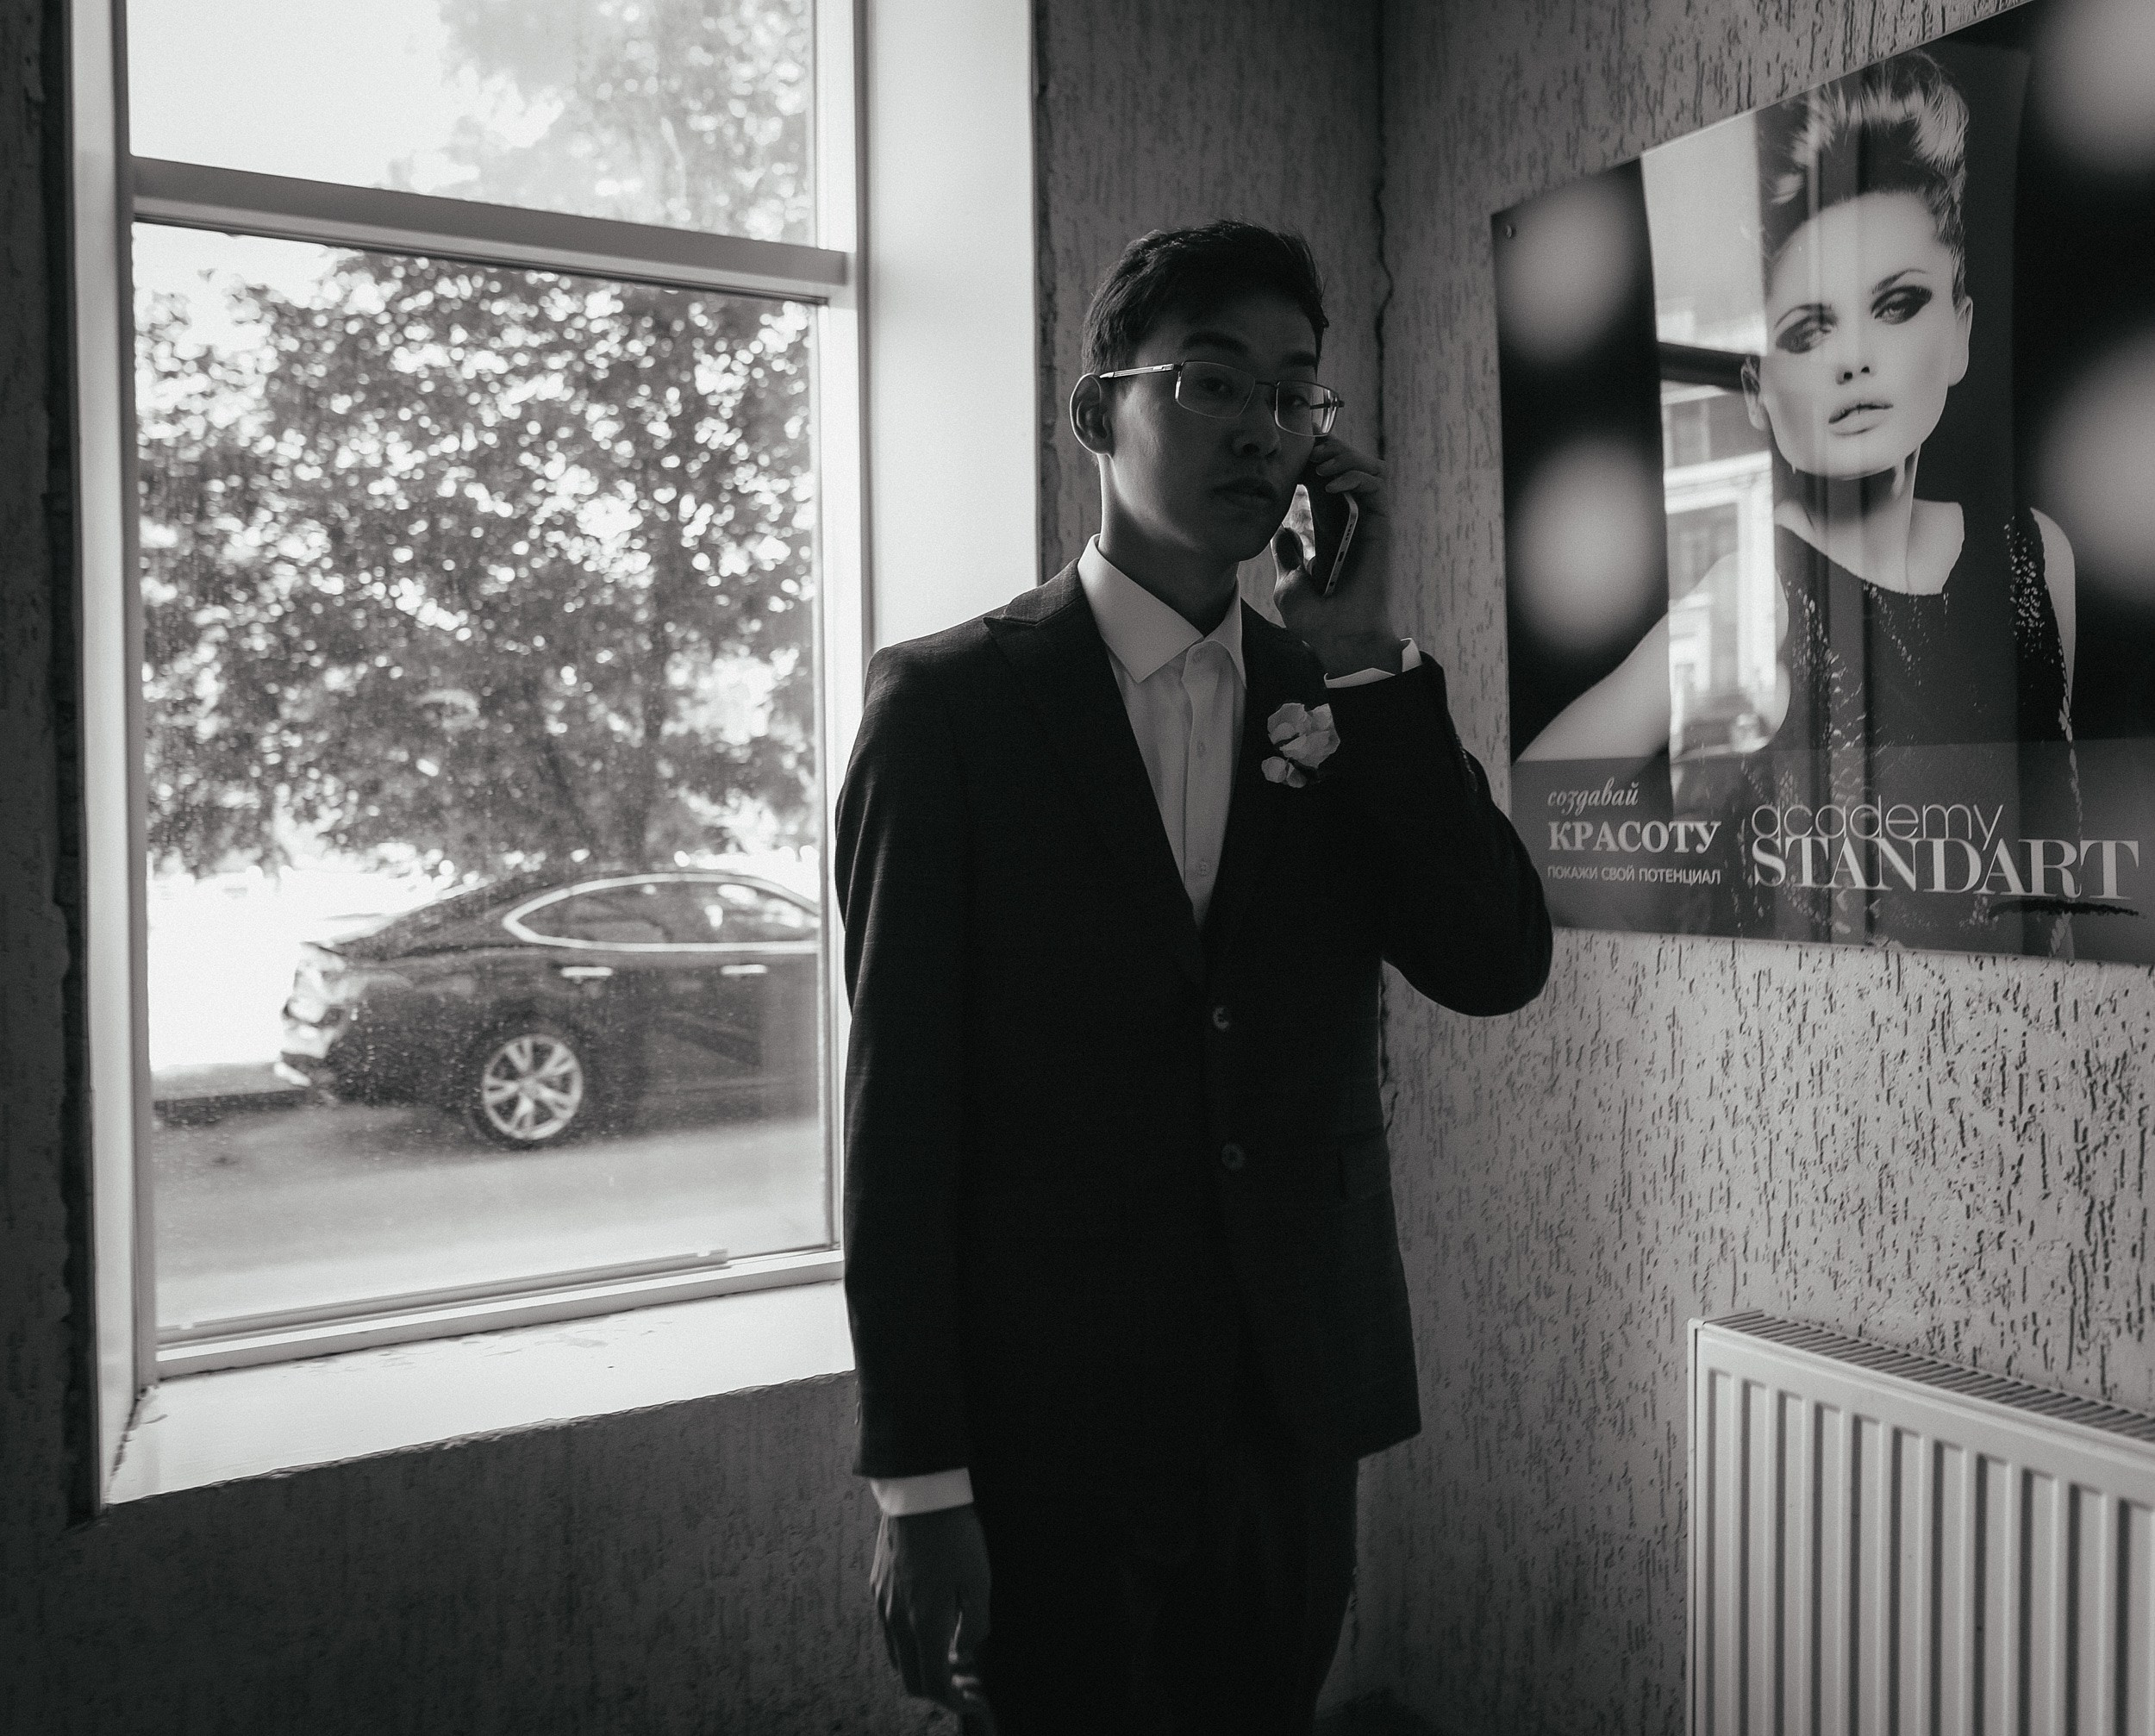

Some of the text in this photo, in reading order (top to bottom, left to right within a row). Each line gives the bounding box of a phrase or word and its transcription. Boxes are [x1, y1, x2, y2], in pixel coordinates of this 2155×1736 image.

[1548, 820, 1722, 854] КРАСОТУ
[1547, 865, 1721, 886] ПОКАЖИ СВОЙ ПОТЕНЦИАЛ
[1752, 837, 2139, 900] STANDART
